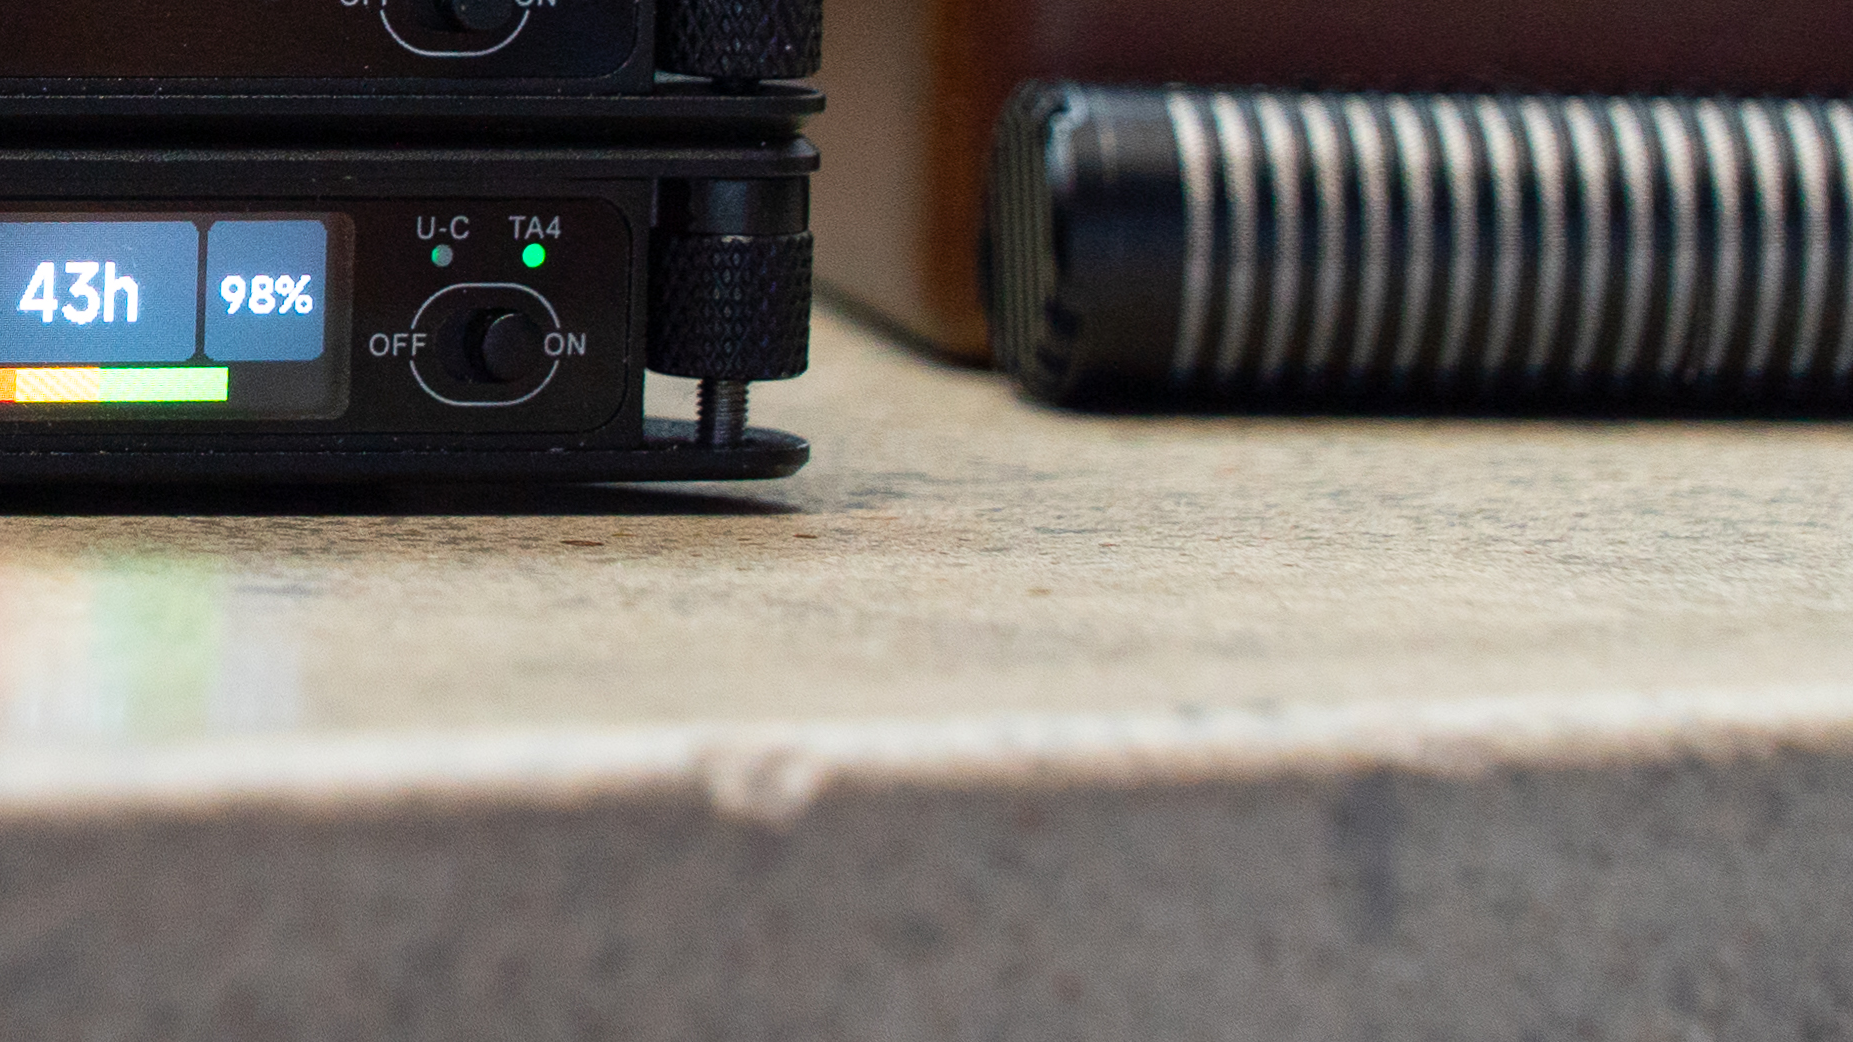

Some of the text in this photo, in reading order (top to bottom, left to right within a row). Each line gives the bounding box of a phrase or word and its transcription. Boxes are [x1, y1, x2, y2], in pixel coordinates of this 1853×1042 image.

[416, 215, 470, 240] U-C
[508, 215, 562, 240] TA4
[17, 261, 140, 325] 43h
[220, 274, 314, 315] 98%
[368, 332, 428, 357] OFF
[544, 332, 587, 357] ON
